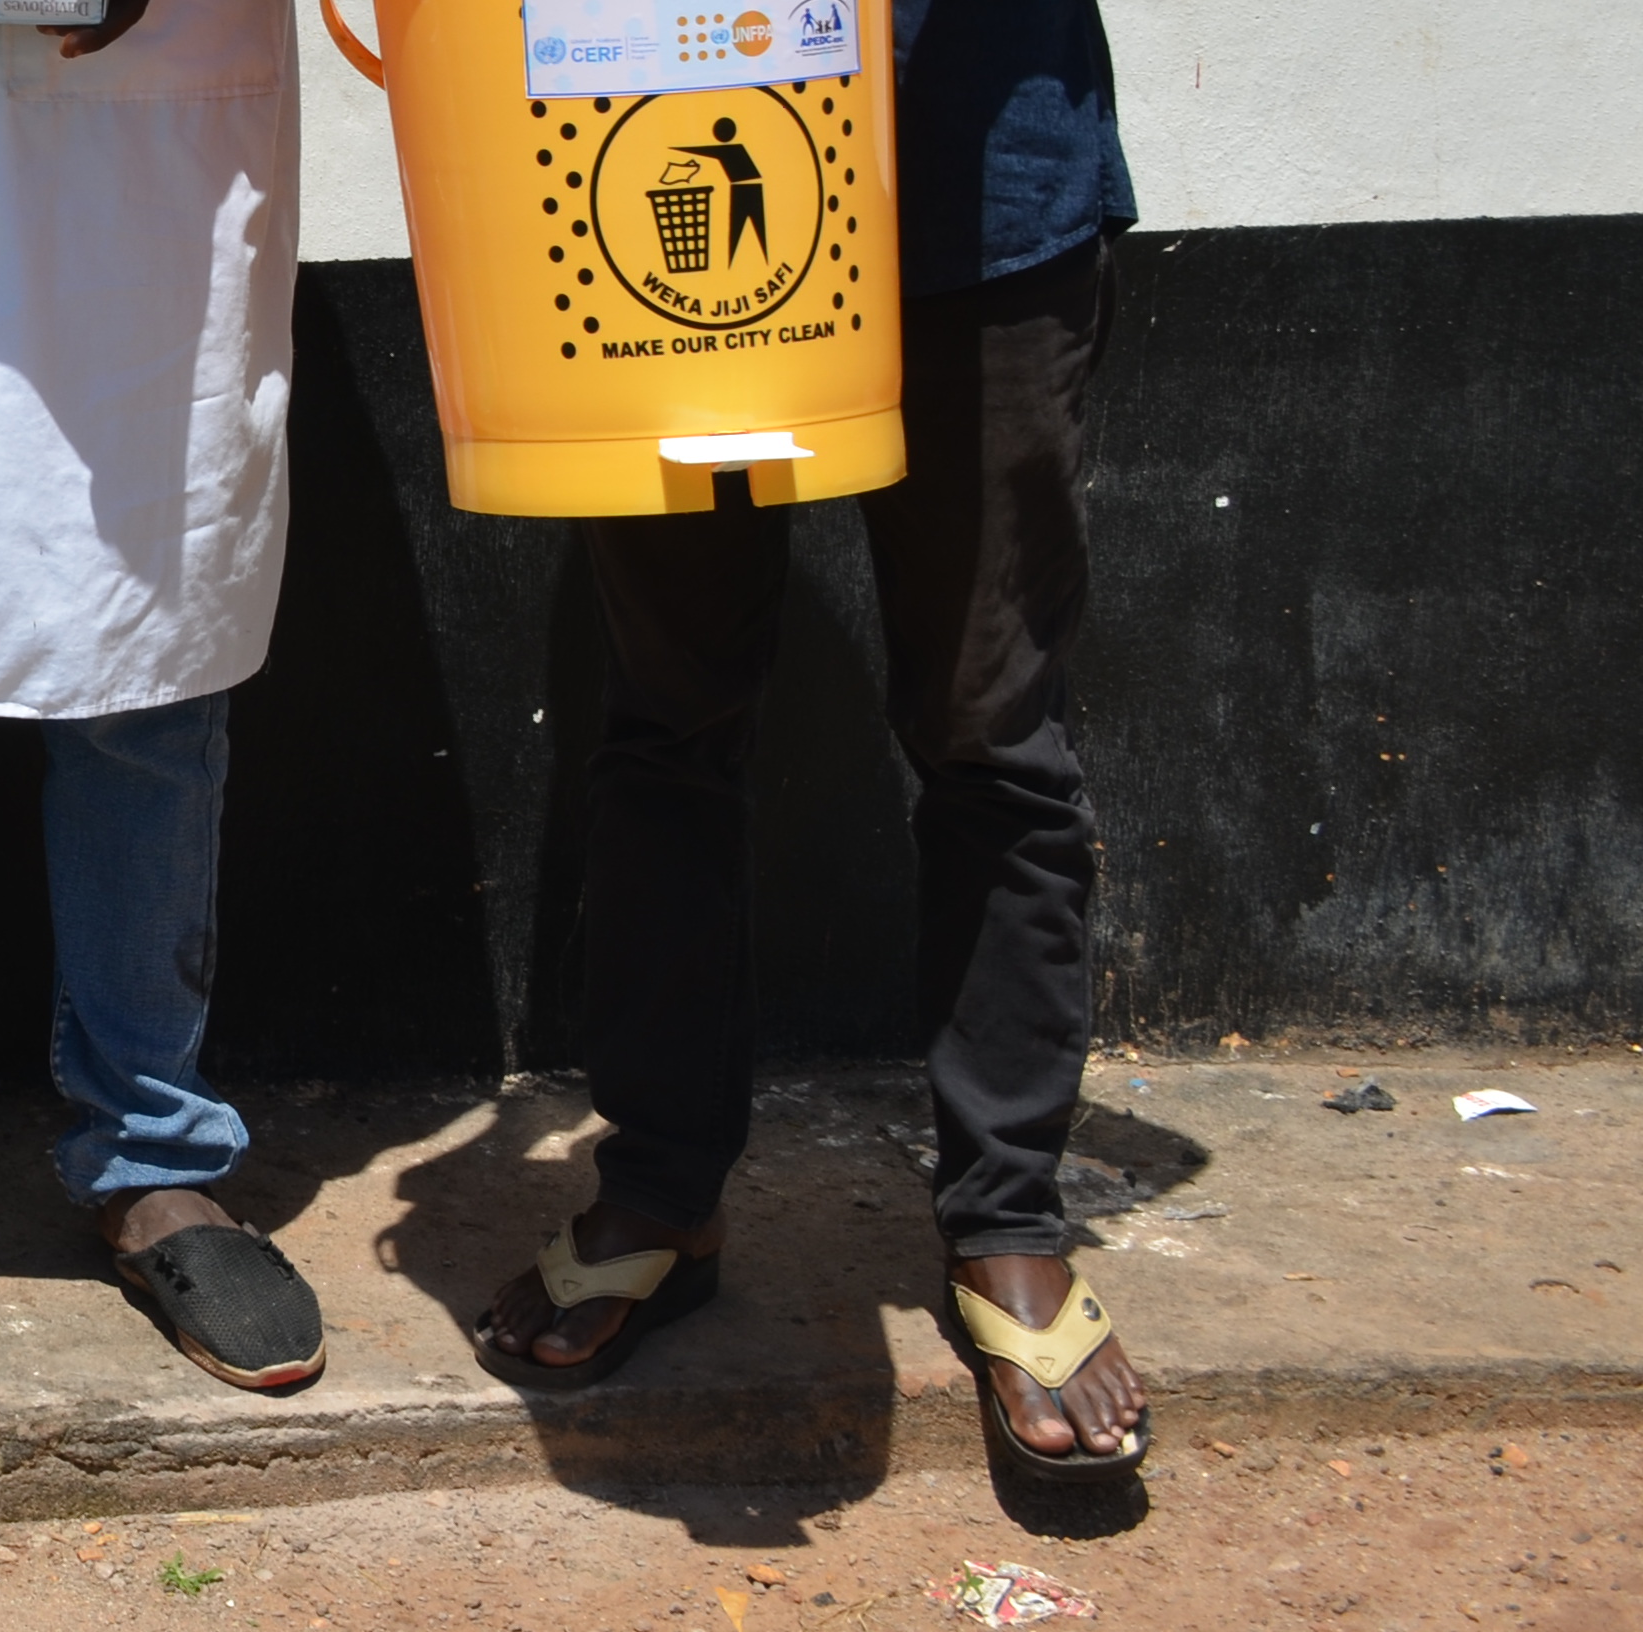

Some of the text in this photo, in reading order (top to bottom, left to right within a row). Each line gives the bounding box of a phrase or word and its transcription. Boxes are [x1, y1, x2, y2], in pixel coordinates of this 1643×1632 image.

[731, 24, 774, 44] UNFPA
[571, 46, 623, 63] CERF
[641, 261, 794, 317] WEKA JIJI SAFI
[601, 320, 836, 360] MAKE OUR CITY CLEAN
